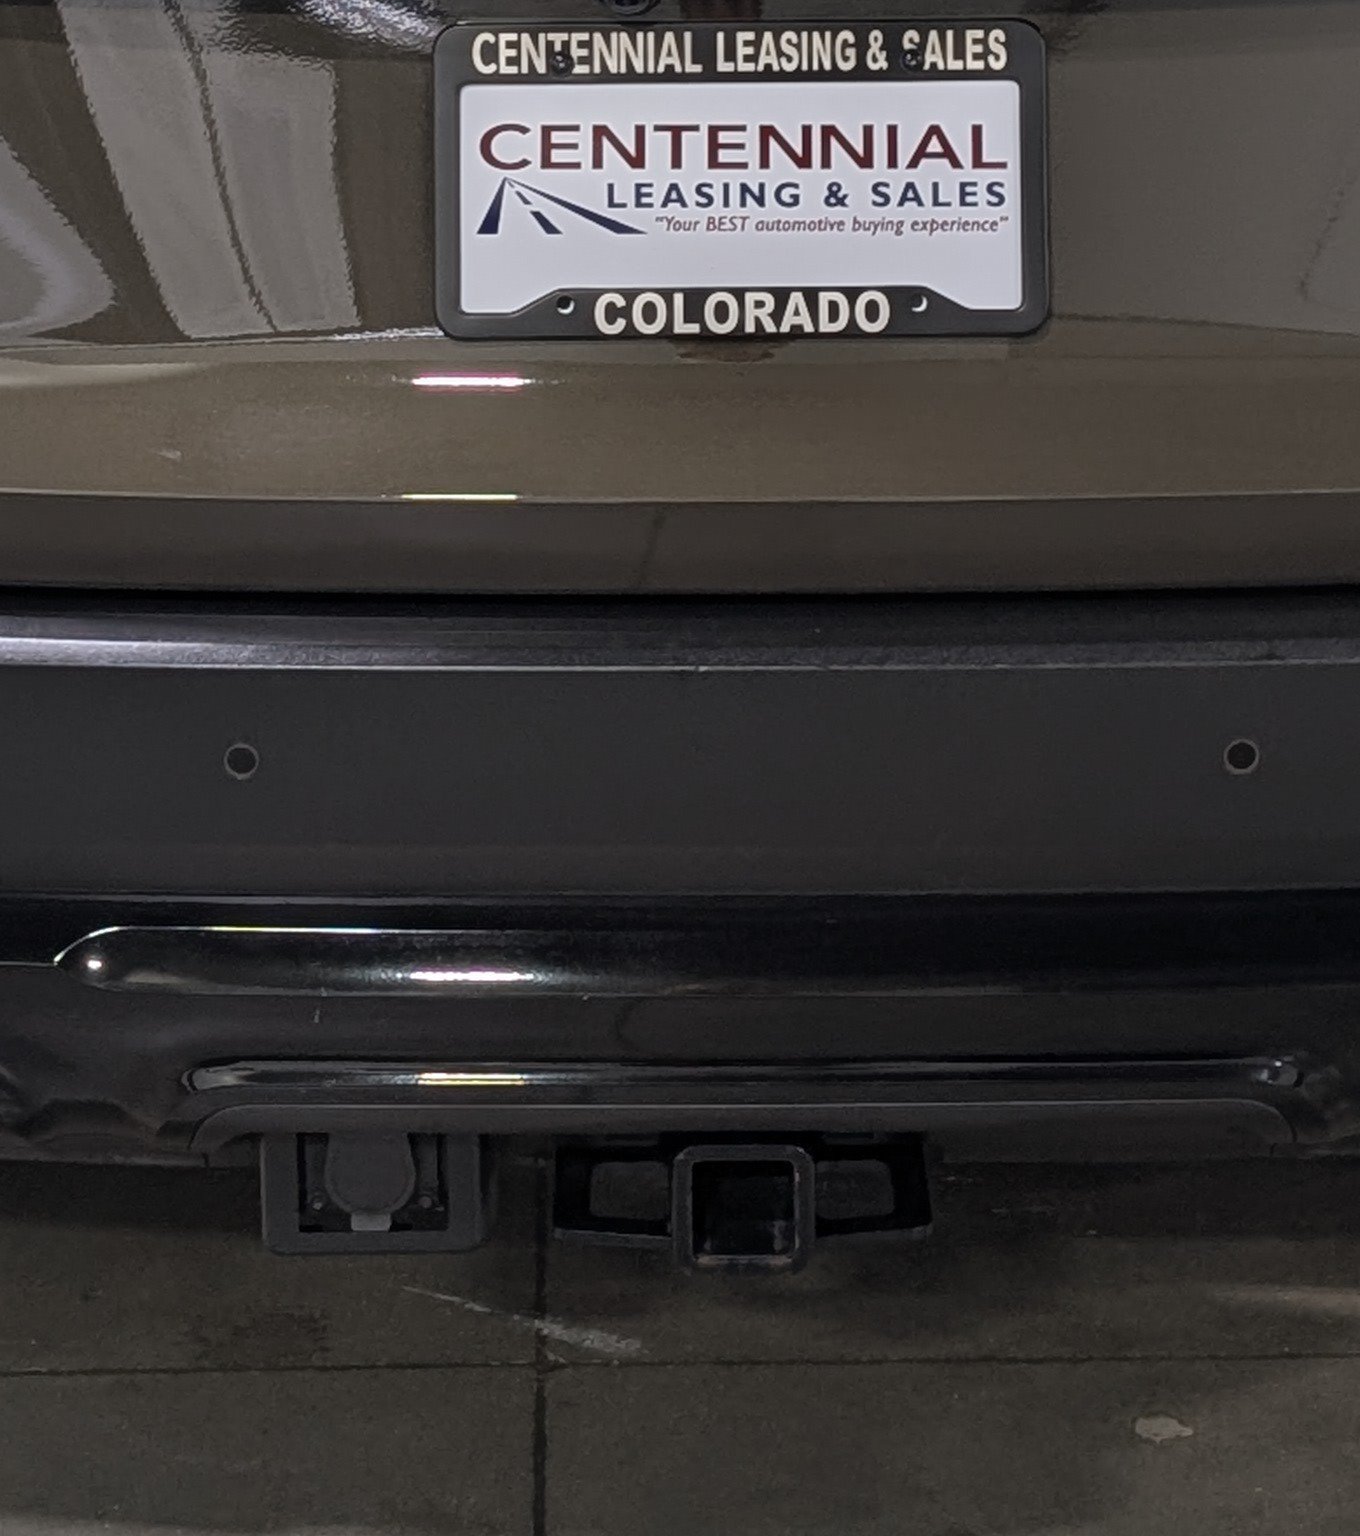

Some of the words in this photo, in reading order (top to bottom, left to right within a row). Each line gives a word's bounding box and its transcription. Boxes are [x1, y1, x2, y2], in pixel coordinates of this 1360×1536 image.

[471, 31, 703, 75] CENTENNIAL
[715, 30, 858, 73] LEASING
[865, 28, 889, 71] &
[478, 123, 1008, 171] CENTENNIAL
[606, 181, 801, 209] LEASING
[823, 181, 849, 209] &
[870, 180, 1007, 208] SALES
[655, 215, 700, 233] "Your
[705, 215, 750, 233] BEST
[755, 215, 846, 233] automotive
[851, 215, 904, 236] buying
[910, 214, 1009, 236] experience"
[593, 290, 891, 336] COLORADO
